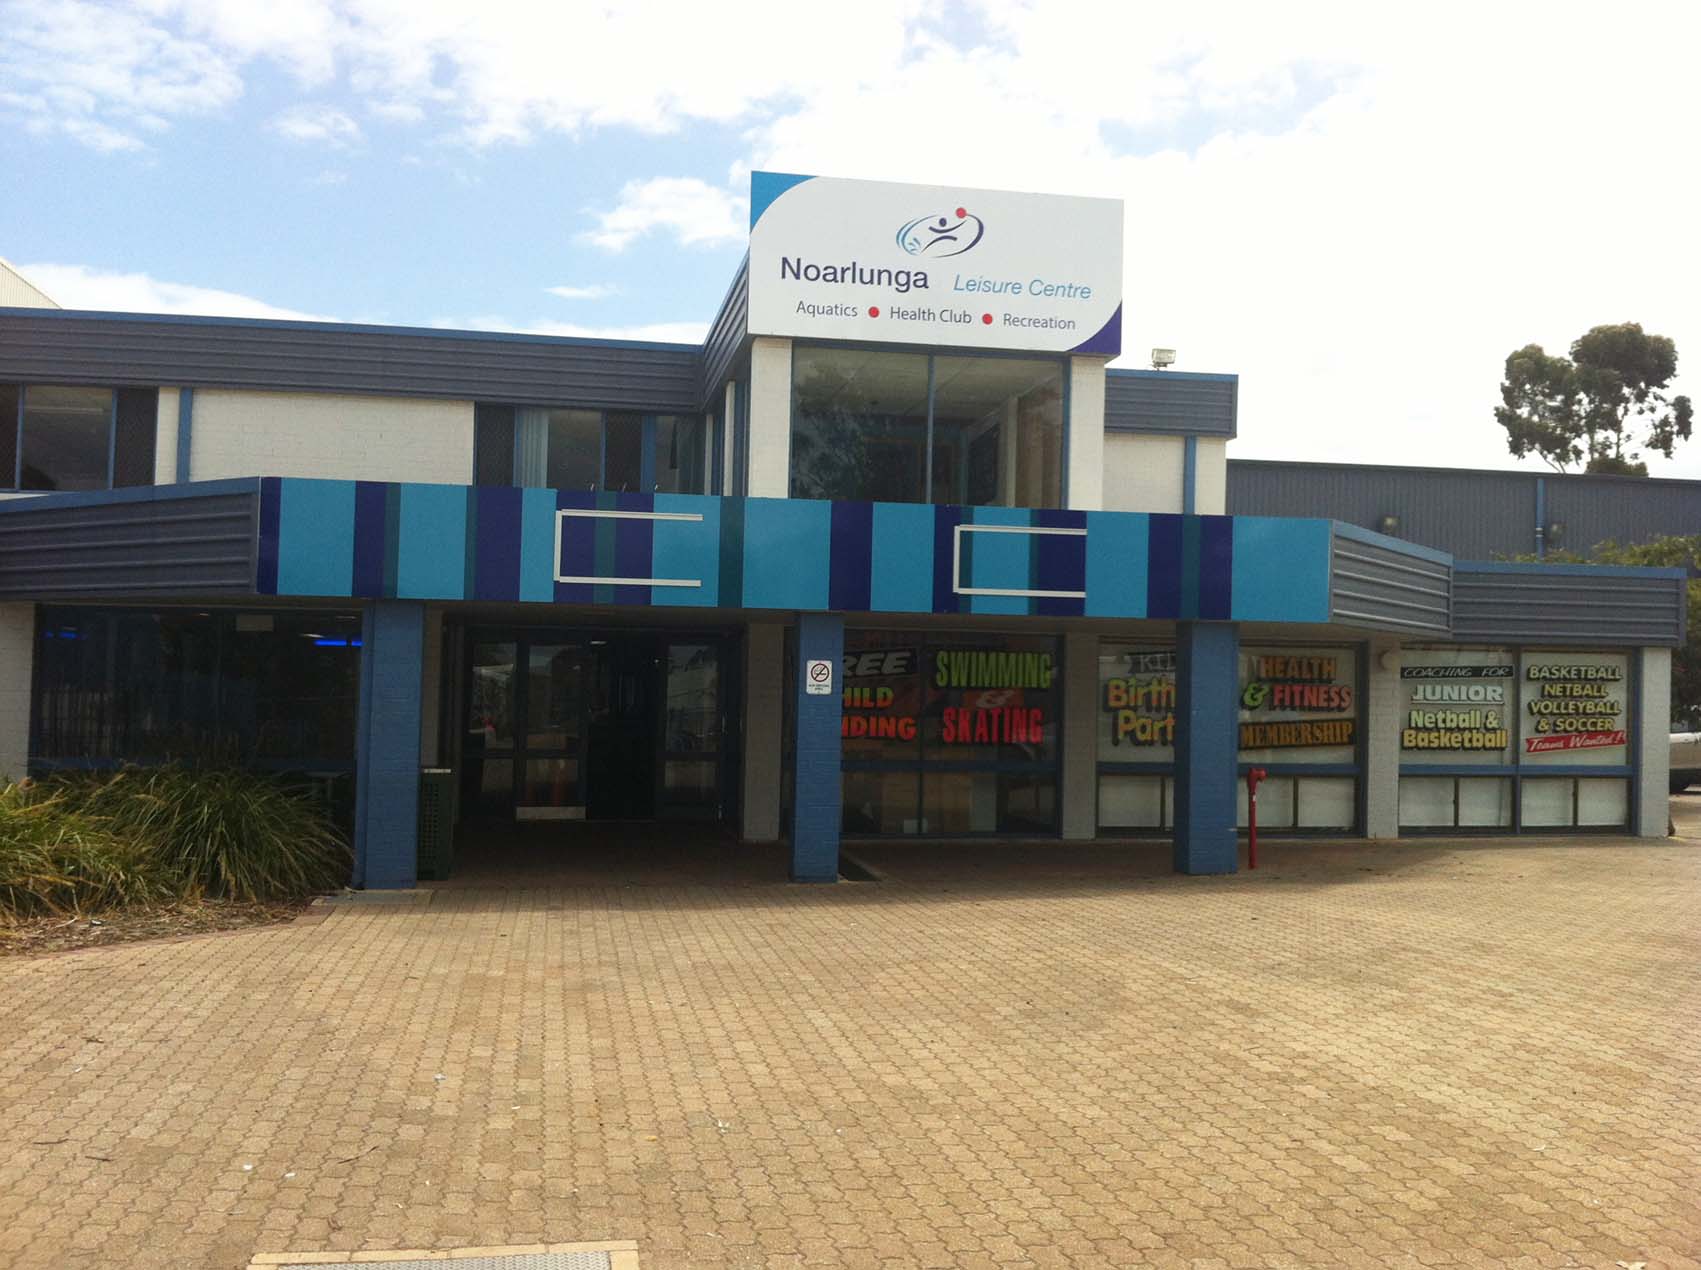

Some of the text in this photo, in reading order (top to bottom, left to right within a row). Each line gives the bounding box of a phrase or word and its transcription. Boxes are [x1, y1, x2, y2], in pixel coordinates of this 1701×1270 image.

[781, 256, 1092, 300] Noarlunga Leisure Centre
[796, 301, 1076, 330] Aquatics Health Club Recreation
[843, 652, 910, 676] REE
[936, 650, 1051, 687] SWIMMING
[1258, 655, 1336, 680] HEALTH
[1404, 667, 1509, 677] COACHING FOR
[1528, 665, 1622, 680] BASKETBALL
[1107, 676, 1176, 706] Birth
[1242, 682, 1352, 708] & FITNESS
[1412, 684, 1503, 701] JUNIOR
[1542, 683, 1607, 696] NETBALL
[1529, 700, 1621, 714] VOLLEYBALL
[943, 706, 1042, 744] SKATING
[1118, 707, 1175, 740] Part
[1410, 710, 1499, 729] Netball &
[1537, 718, 1614, 731] & SOCCER
[1240, 721, 1352, 748] MEMBERSHIP
[1403, 729, 1507, 748] Basketball
